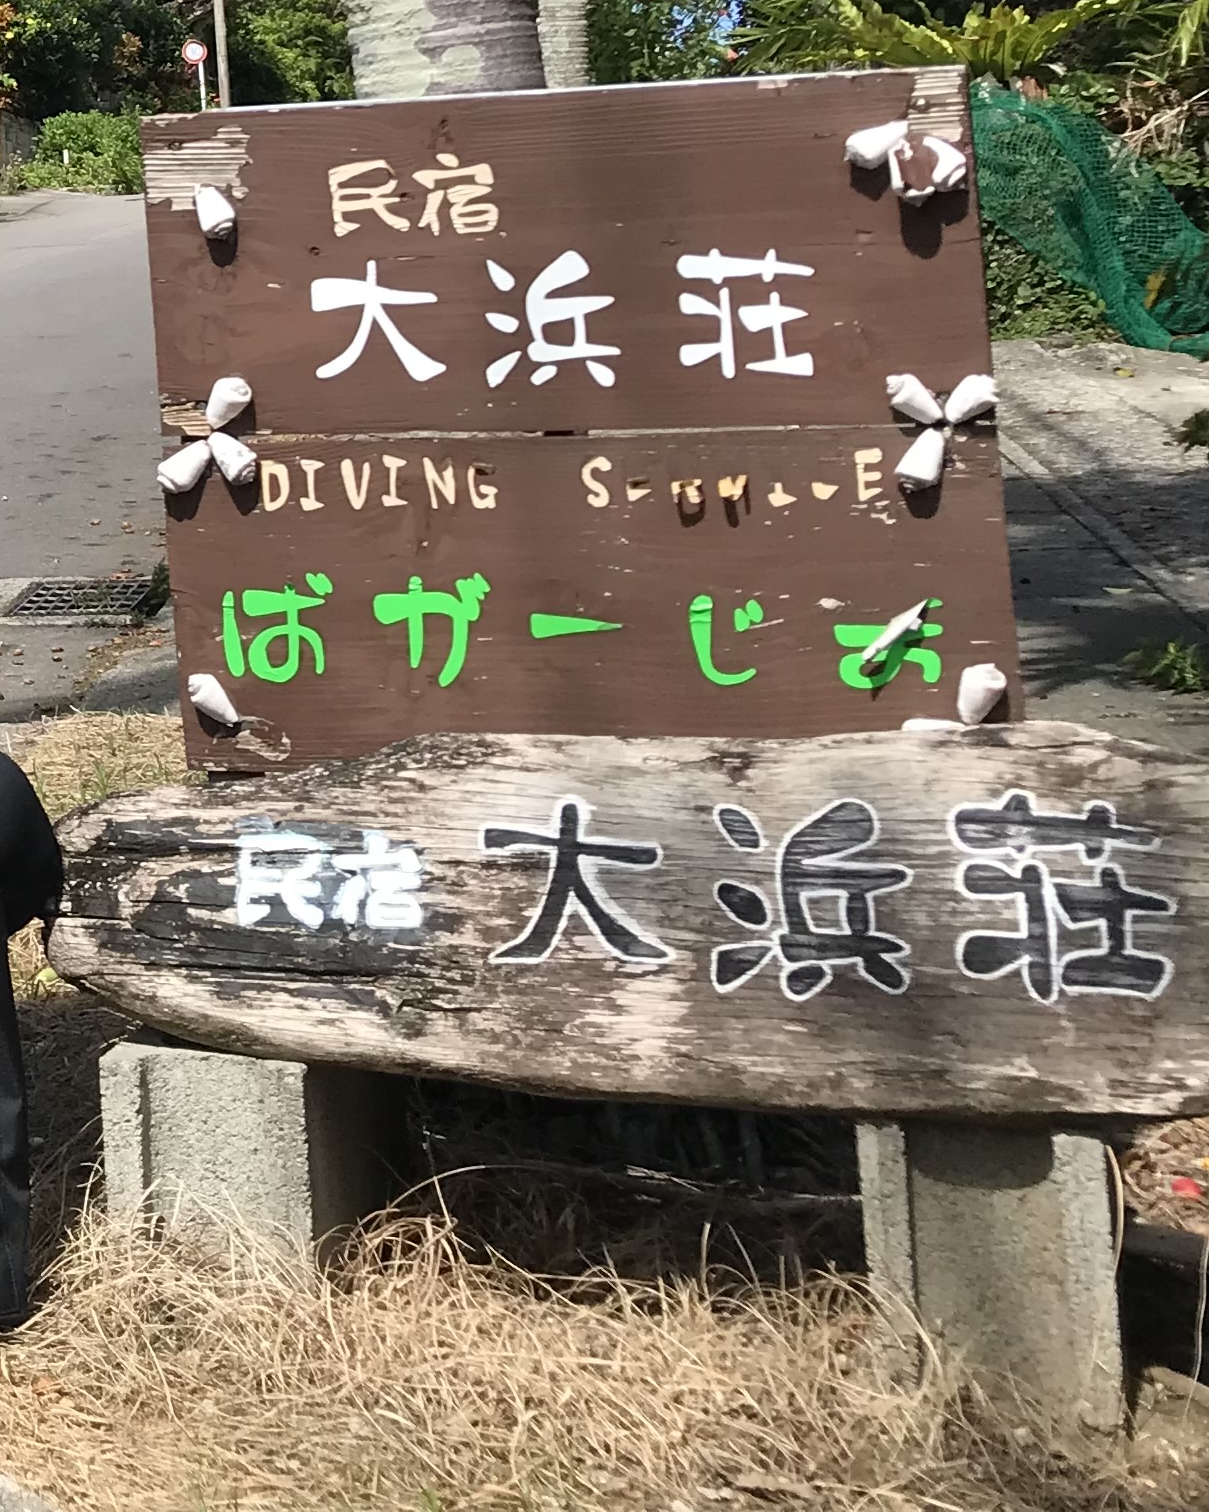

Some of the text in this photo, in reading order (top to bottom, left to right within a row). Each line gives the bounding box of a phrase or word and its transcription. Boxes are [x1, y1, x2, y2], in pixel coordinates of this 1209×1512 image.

[327, 153, 501, 237] 民宿
[310, 247, 816, 388] 大浜荘
[261, 454, 499, 512] DIVING
[235, 791, 1178, 1003] 民宿 大浜荘
